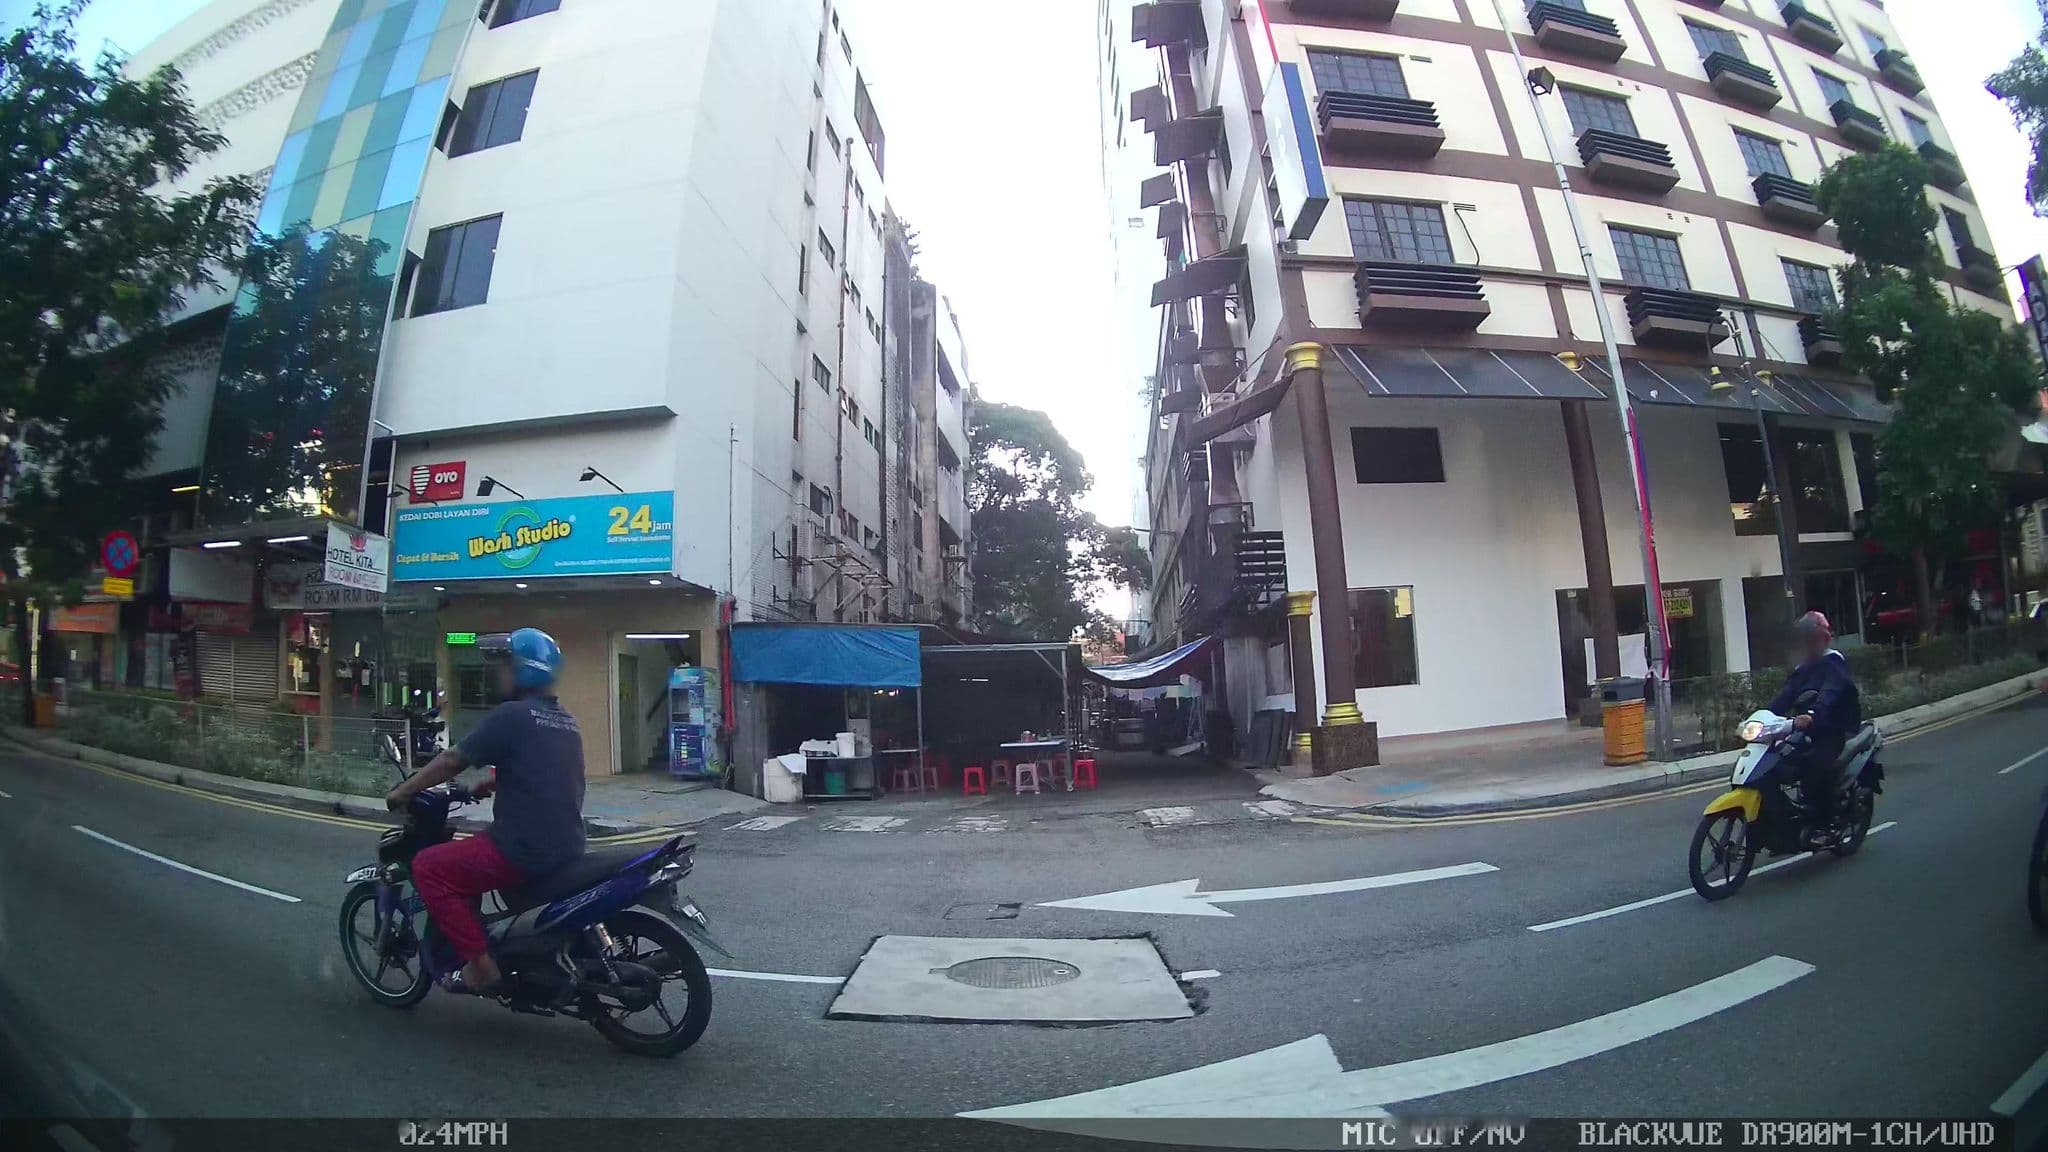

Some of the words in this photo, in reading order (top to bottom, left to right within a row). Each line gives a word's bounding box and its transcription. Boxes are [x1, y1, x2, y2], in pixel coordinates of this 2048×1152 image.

[435, 472, 458, 484] OYO
[443, 510, 470, 518] LAYAN
[472, 507, 489, 516] DIRI
[608, 505, 652, 535] 24
[652, 521, 671, 532] jam
[468, 532, 512, 557] Wash
[516, 519, 571, 547] Studio
[328, 547, 354, 565] HOTEL
[356, 555, 373, 569] KITA
